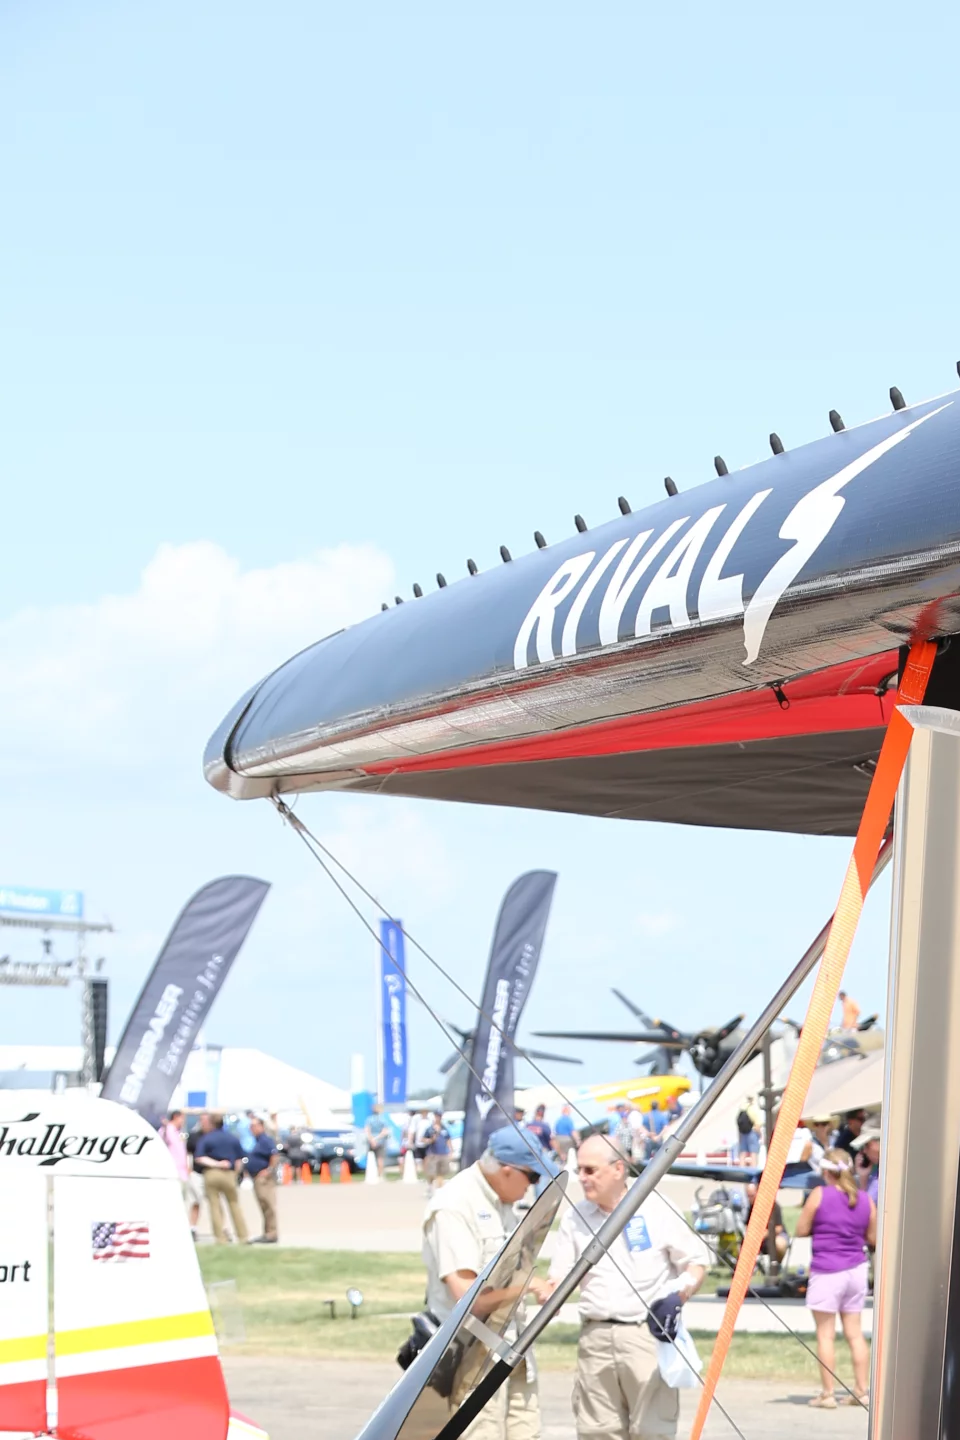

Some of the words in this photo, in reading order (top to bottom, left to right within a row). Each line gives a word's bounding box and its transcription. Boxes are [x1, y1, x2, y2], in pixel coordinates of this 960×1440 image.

[514, 487, 773, 670] RIVAL
[119, 983, 184, 1104] EMBRAER
[0, 1112, 154, 1167] hallenger
